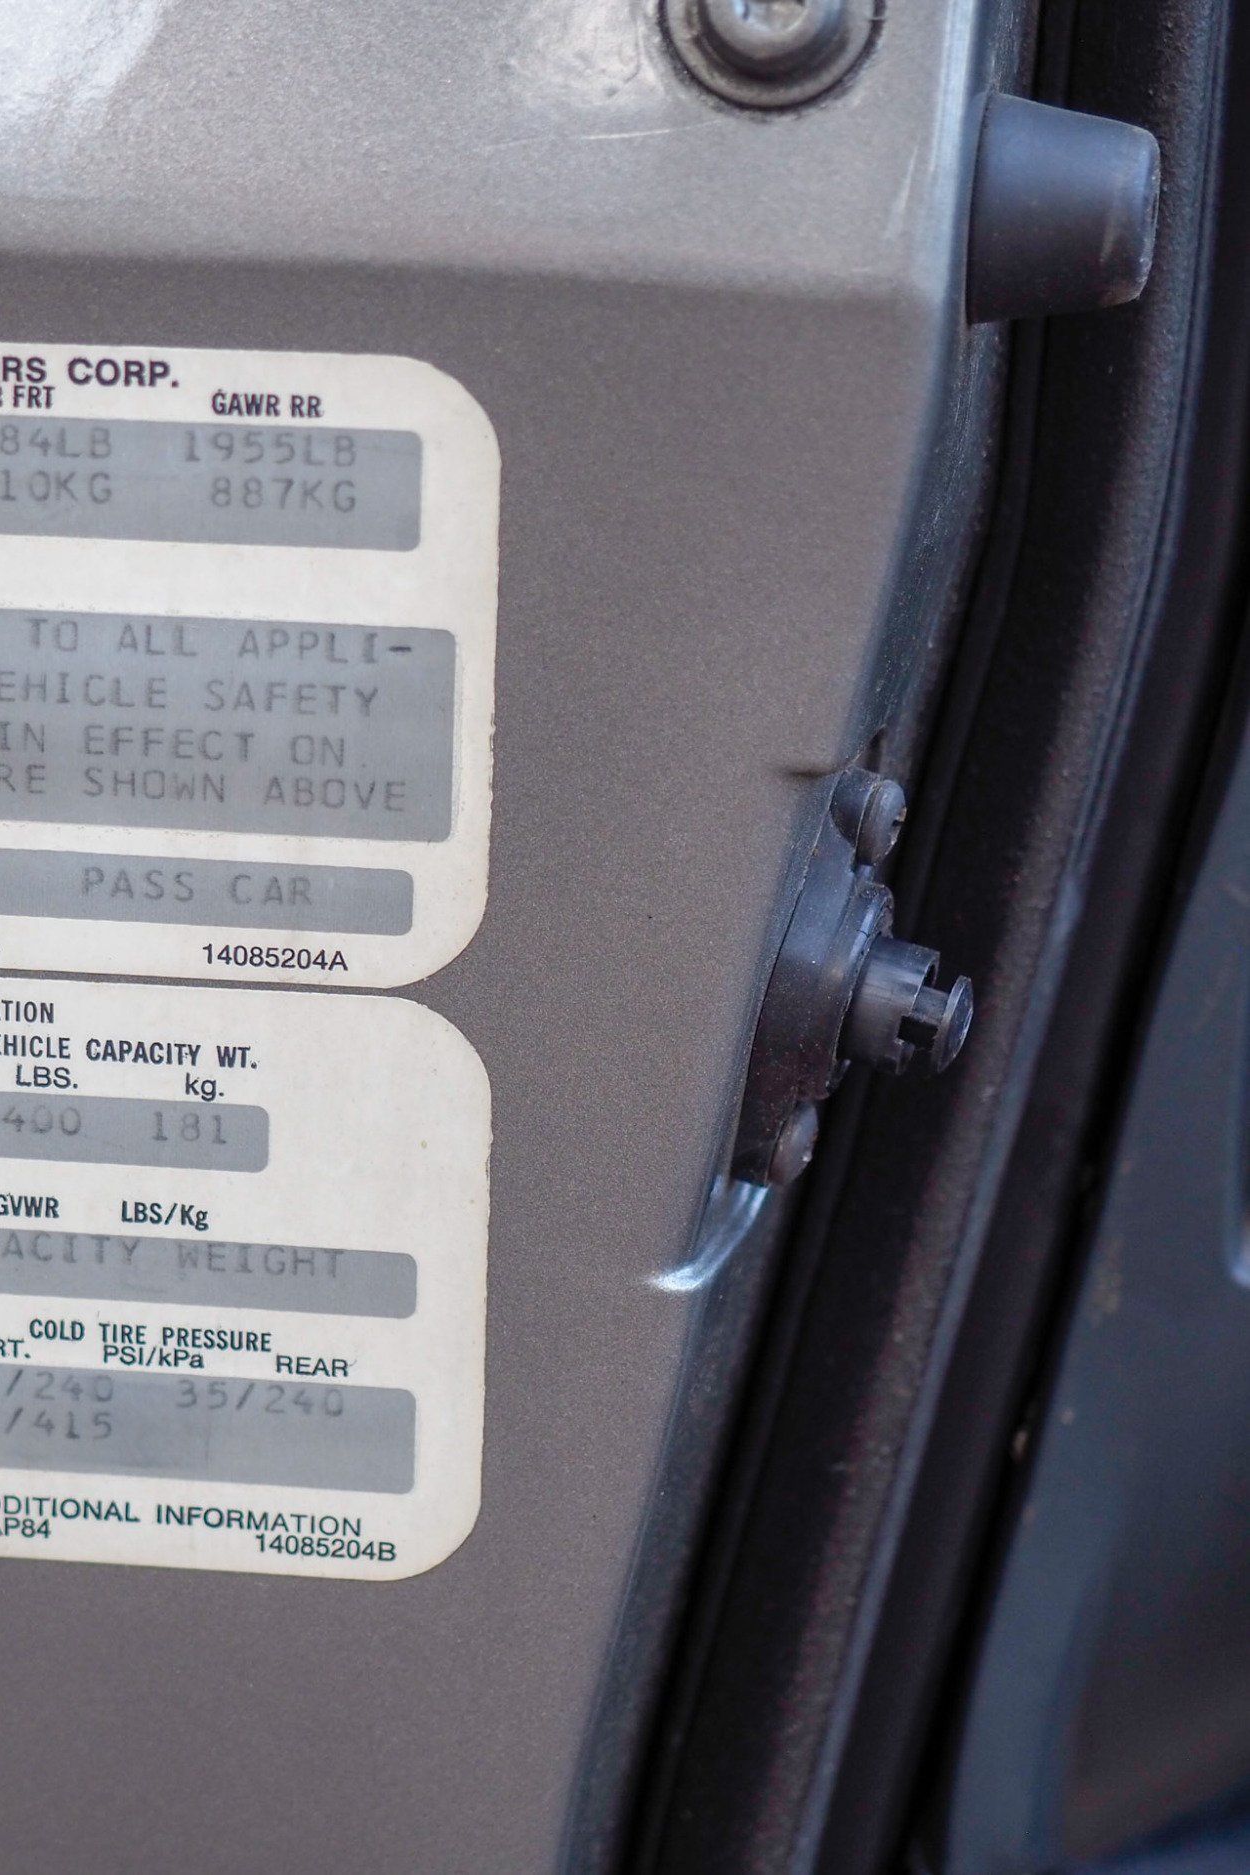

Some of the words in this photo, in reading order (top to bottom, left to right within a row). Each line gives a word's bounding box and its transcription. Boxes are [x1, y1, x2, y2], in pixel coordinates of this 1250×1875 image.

[67, 358, 180, 388] CORP.
[13, 384, 54, 409] FRT
[211, 390, 279, 417] GAWR
[290, 395, 323, 418] RR
[183, 430, 358, 468] 1955LB
[210, 477, 357, 513] 887KG
[27, 619, 80, 651] TO
[117, 624, 198, 657] ALL
[237, 629, 413, 664] APPLI-
[204, 679, 380, 717] SAFETY
[83, 725, 255, 762] EFFECT
[290, 735, 346, 768] ON
[83, 769, 226, 803] SHOWN
[263, 778, 406, 812] ABOVE
[81, 868, 195, 902] PASS
[228, 875, 312, 906] CAR
[202, 943, 348, 971] 14085204A
[86, 1039, 202, 1067] CAPACITY
[217, 1046, 258, 1070] WT.
[15, 1065, 79, 1089] LBS.
[186, 1074, 225, 1101] kg.
[1, 1104, 83, 1136] 400
[151, 1111, 228, 1144] 181
[120, 1200, 209, 1231] LBS/Kg
[177, 1243, 344, 1279] WEIGHT
[29, 1319, 85, 1342] COLD
[98, 1323, 147, 1346] TIRE
[162, 1327, 272, 1353] PRESSURE
[103, 1345, 204, 1369] PSI/kPa
[276, 1356, 349, 1378] REAR
[176, 1378, 344, 1418] 35/240
[156, 1504, 362, 1537] INFORMATION
[255, 1533, 397, 1562] 14085204B
